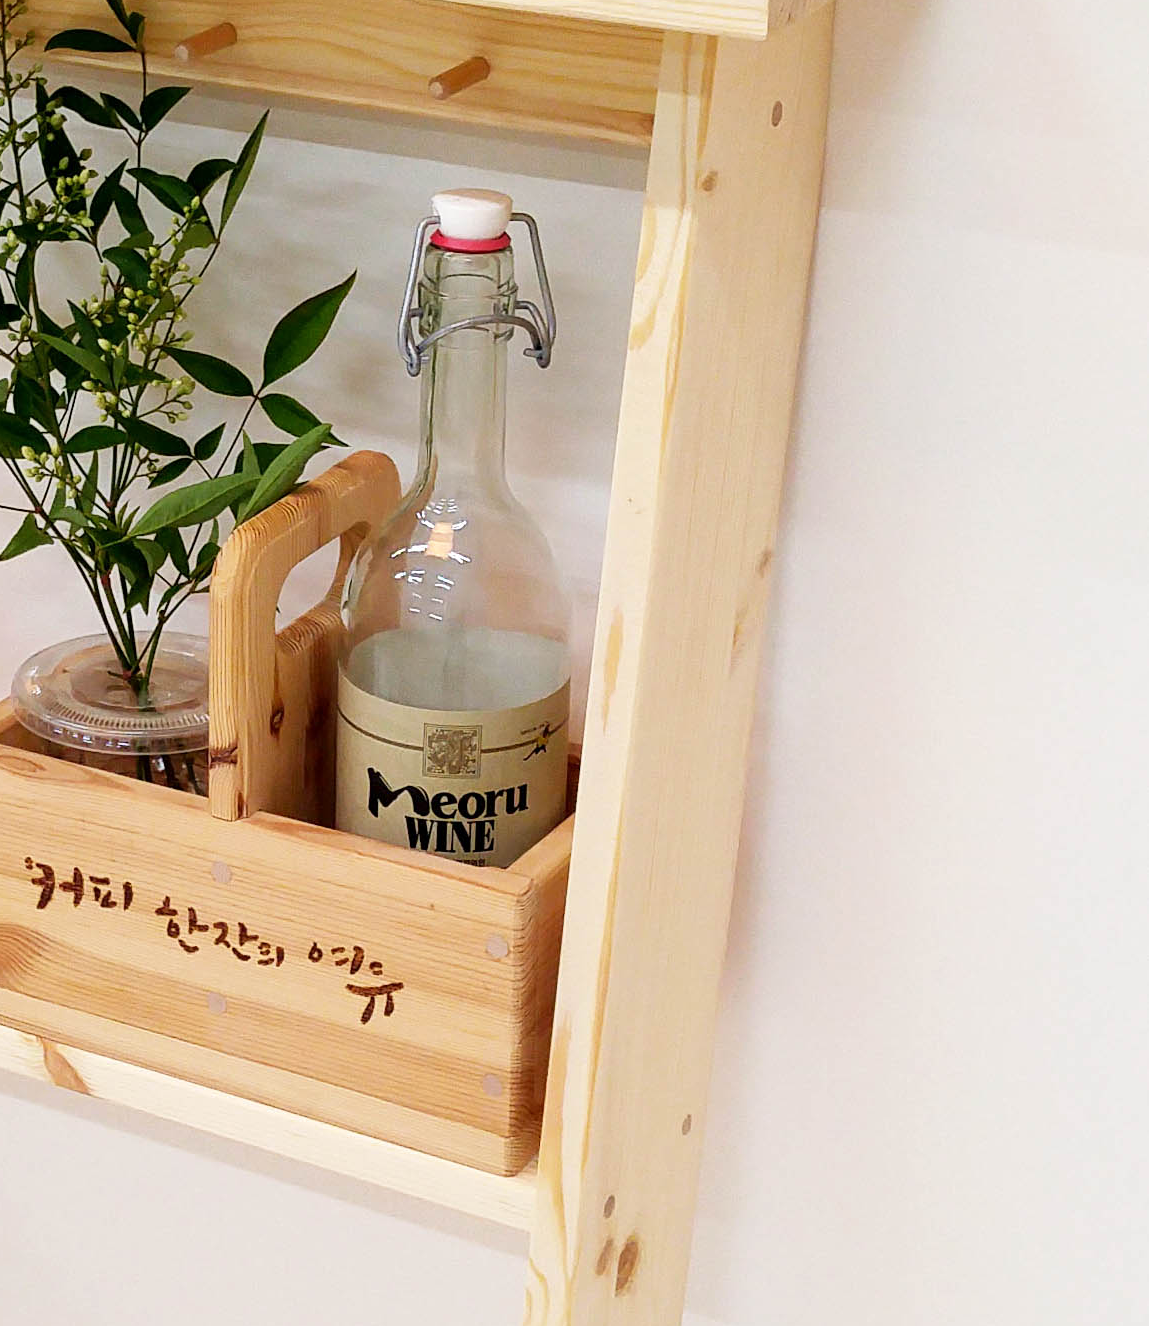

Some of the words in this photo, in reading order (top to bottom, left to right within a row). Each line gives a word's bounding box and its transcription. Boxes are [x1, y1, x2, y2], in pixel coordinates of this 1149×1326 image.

[367, 766, 529, 820] Meoru
[404, 816, 496, 854] WINE
[25, 856, 134, 910] 커피
[154, 895, 284, 968] 한잔의
[307, 943, 404, 1025] 여유
